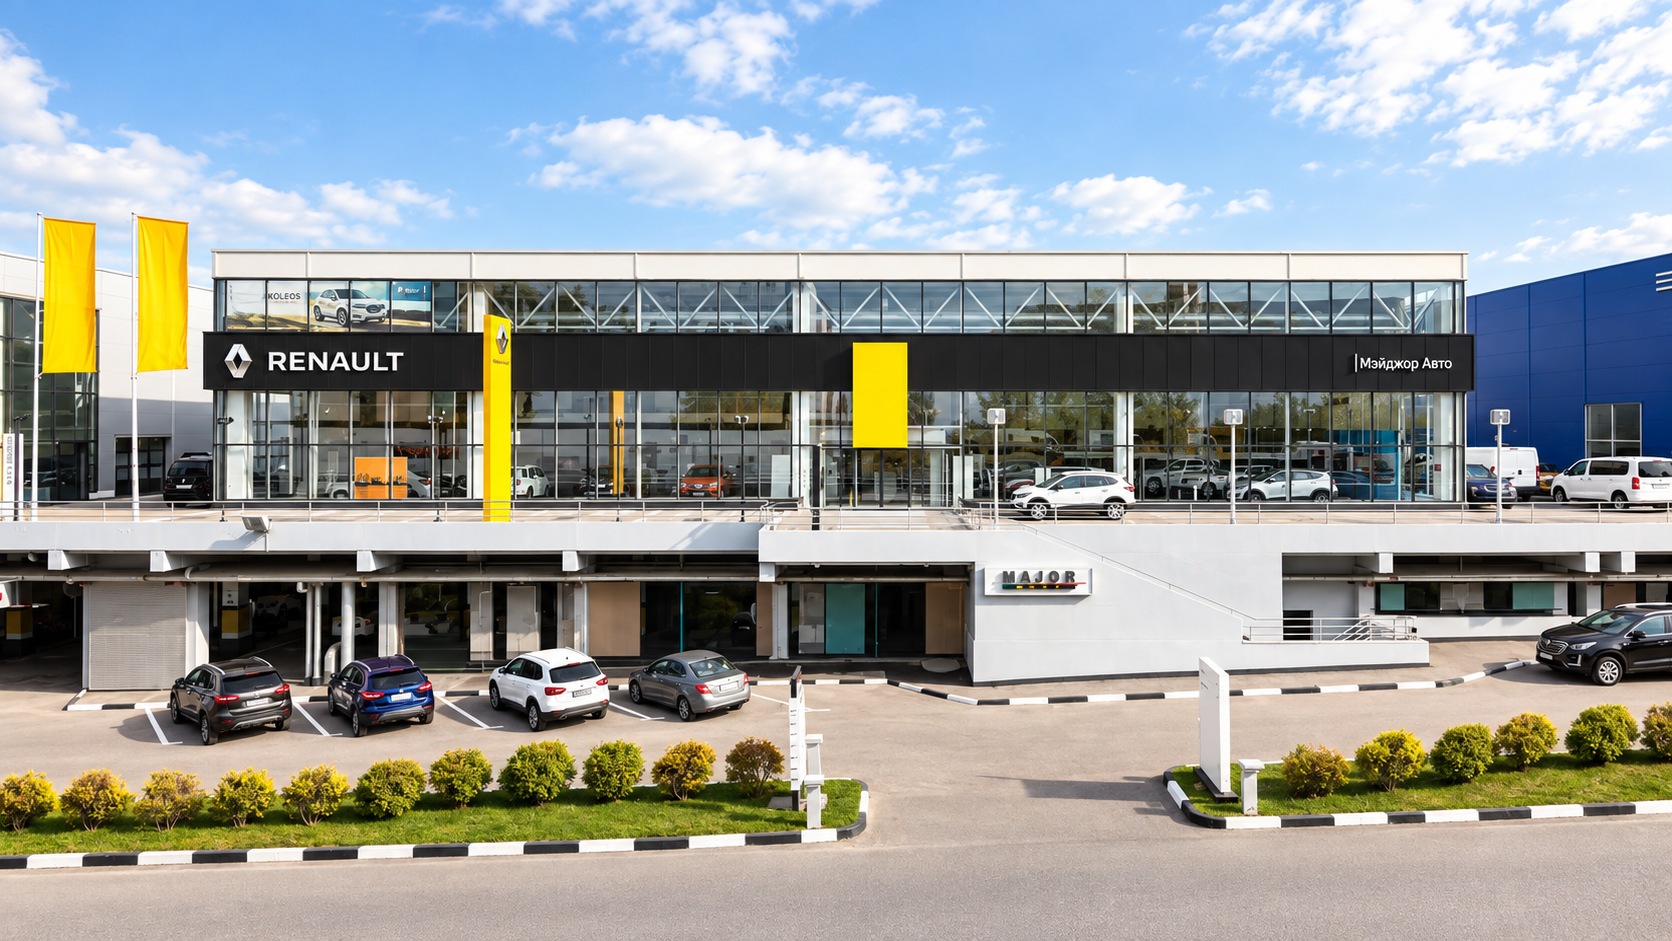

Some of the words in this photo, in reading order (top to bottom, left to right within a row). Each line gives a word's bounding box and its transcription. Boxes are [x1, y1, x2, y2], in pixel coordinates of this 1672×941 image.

[267, 292, 301, 300] KOLEOS
[267, 351, 404, 372] RENAULT
[1360, 357, 1419, 372] Мэйджор
[1422, 357, 1453, 369] Авто
[1002, 570, 1076, 583] MAJOR
